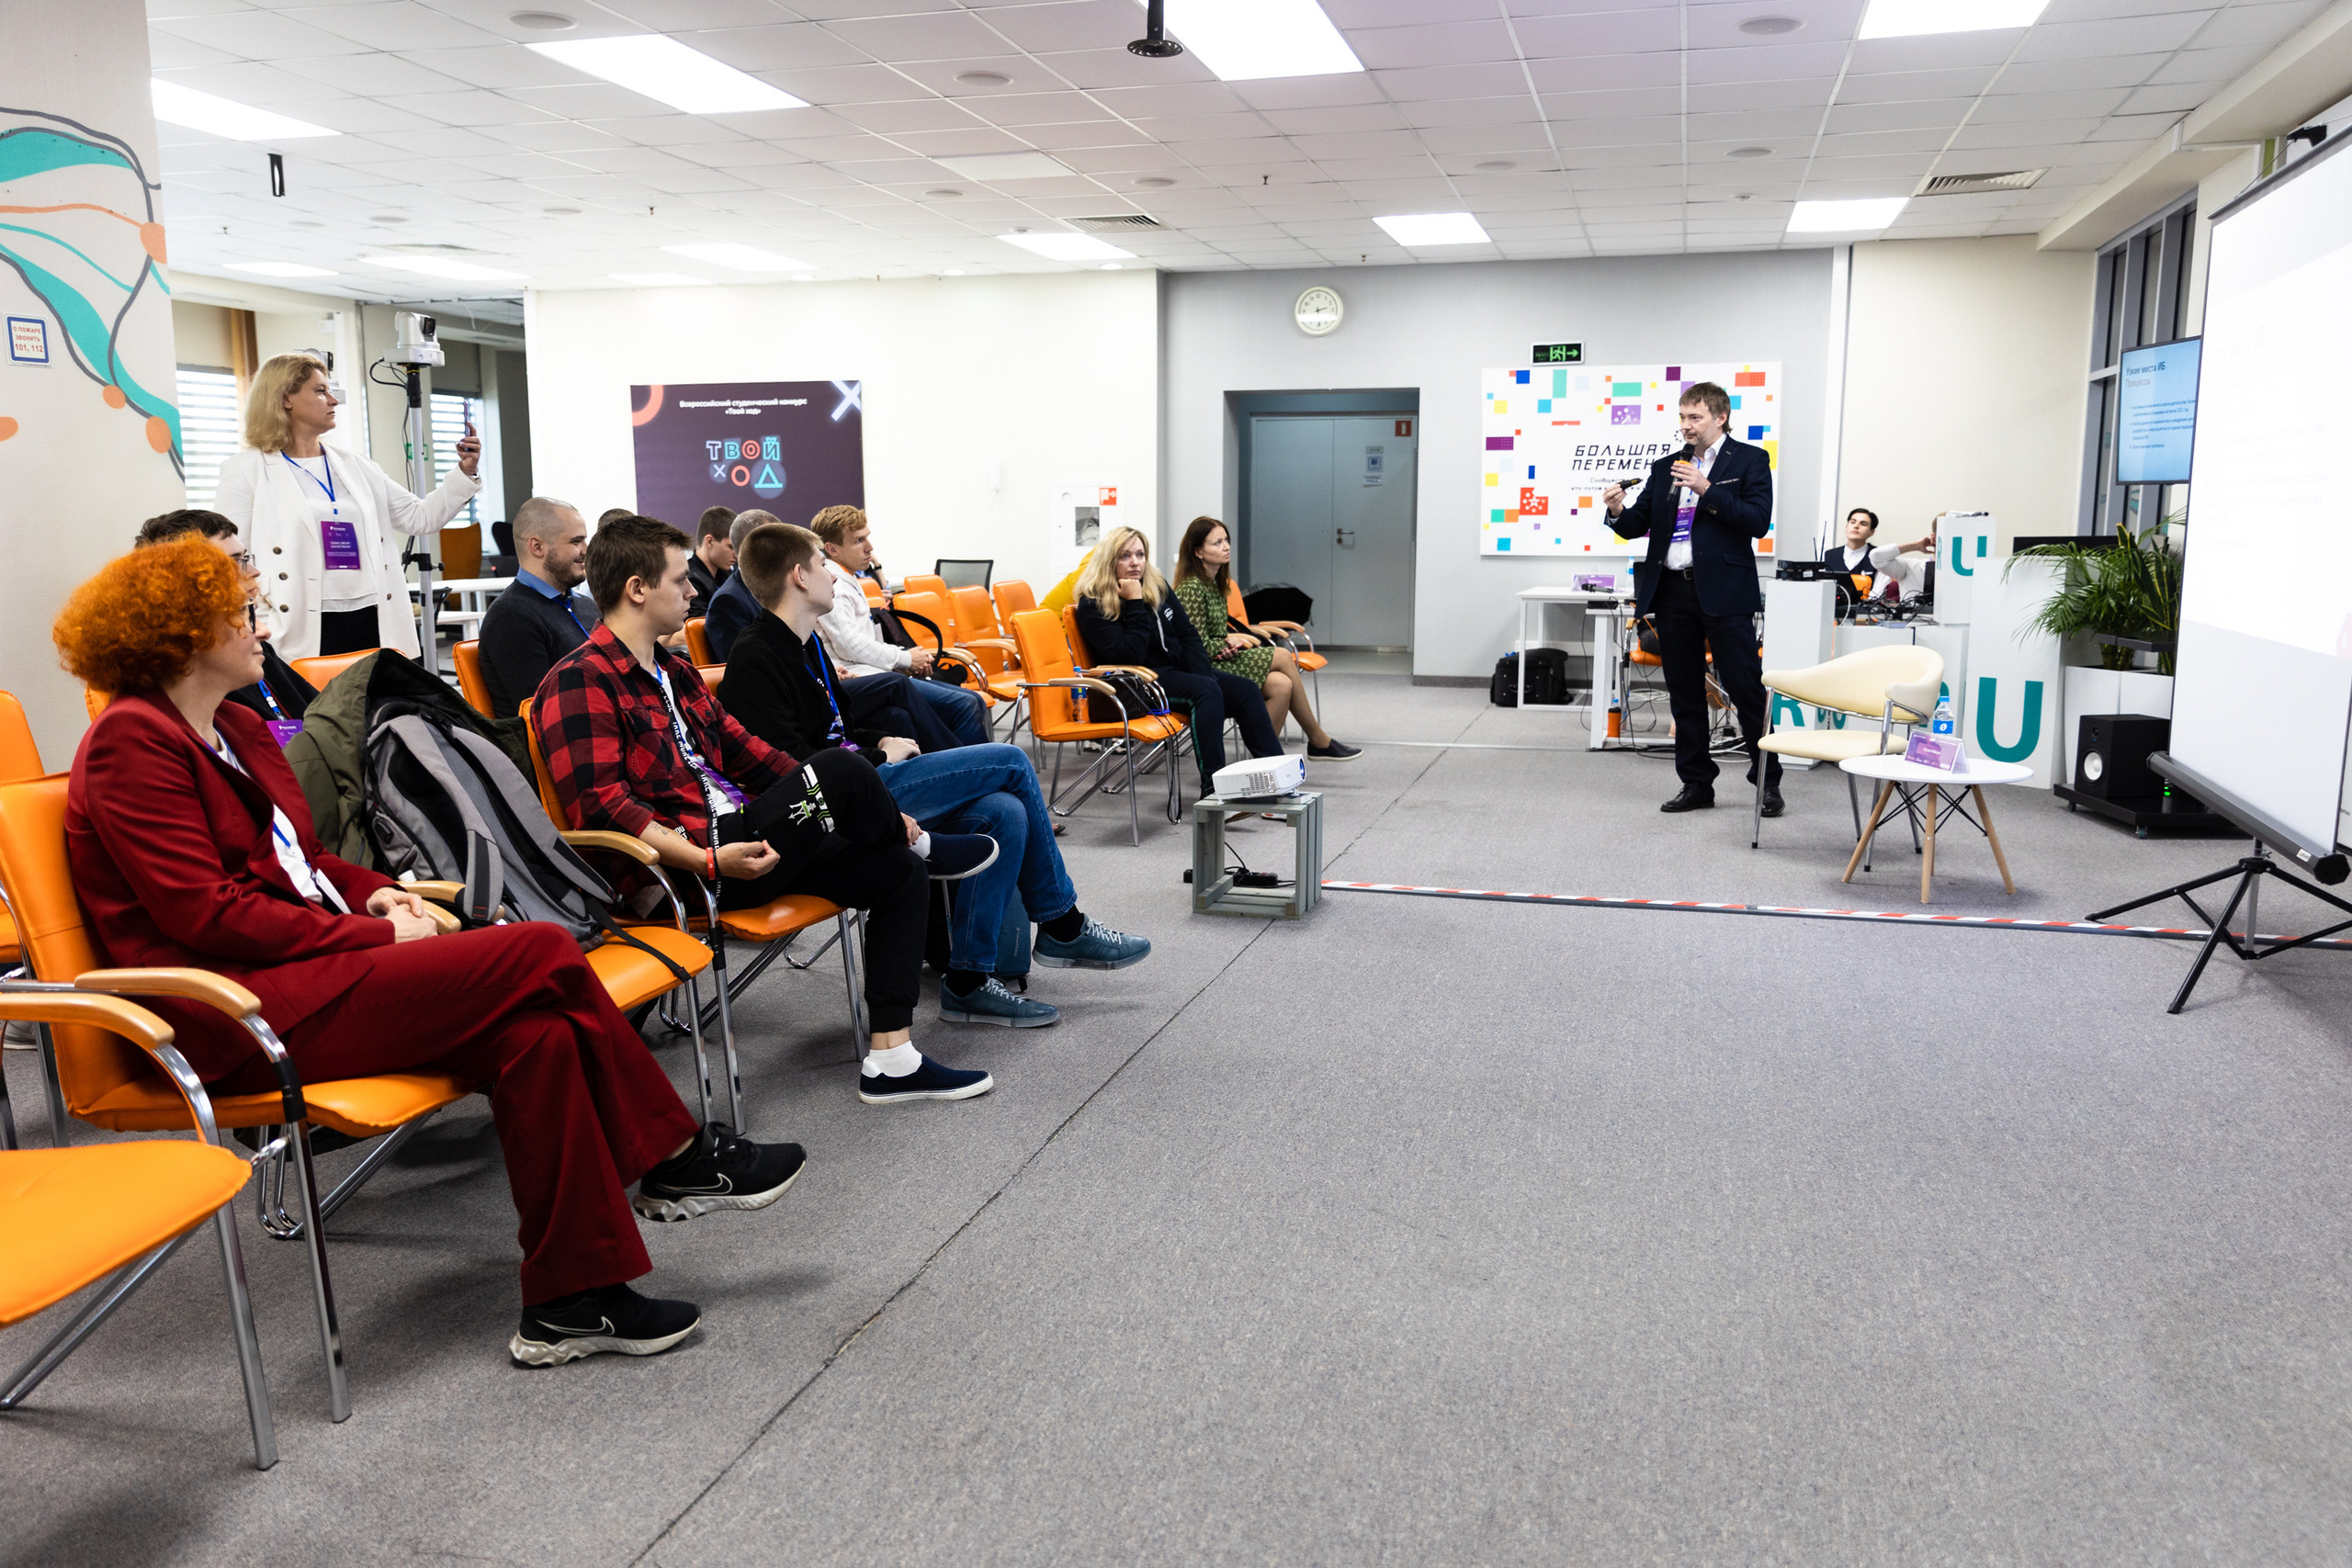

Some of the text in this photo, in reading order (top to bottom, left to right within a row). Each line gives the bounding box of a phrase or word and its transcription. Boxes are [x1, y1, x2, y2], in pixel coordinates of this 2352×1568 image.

[15, 344, 44, 353] 101, 112
[706, 436, 781, 461] ТВОЙ
[1575, 444, 1671, 457] БОЛЬШАЯ
[713, 463, 783, 489] ХОД
[1572, 458, 1655, 470] ПЕРЕМЕН
[1951, 536, 1987, 577] U
[1976, 677, 2043, 763] U
